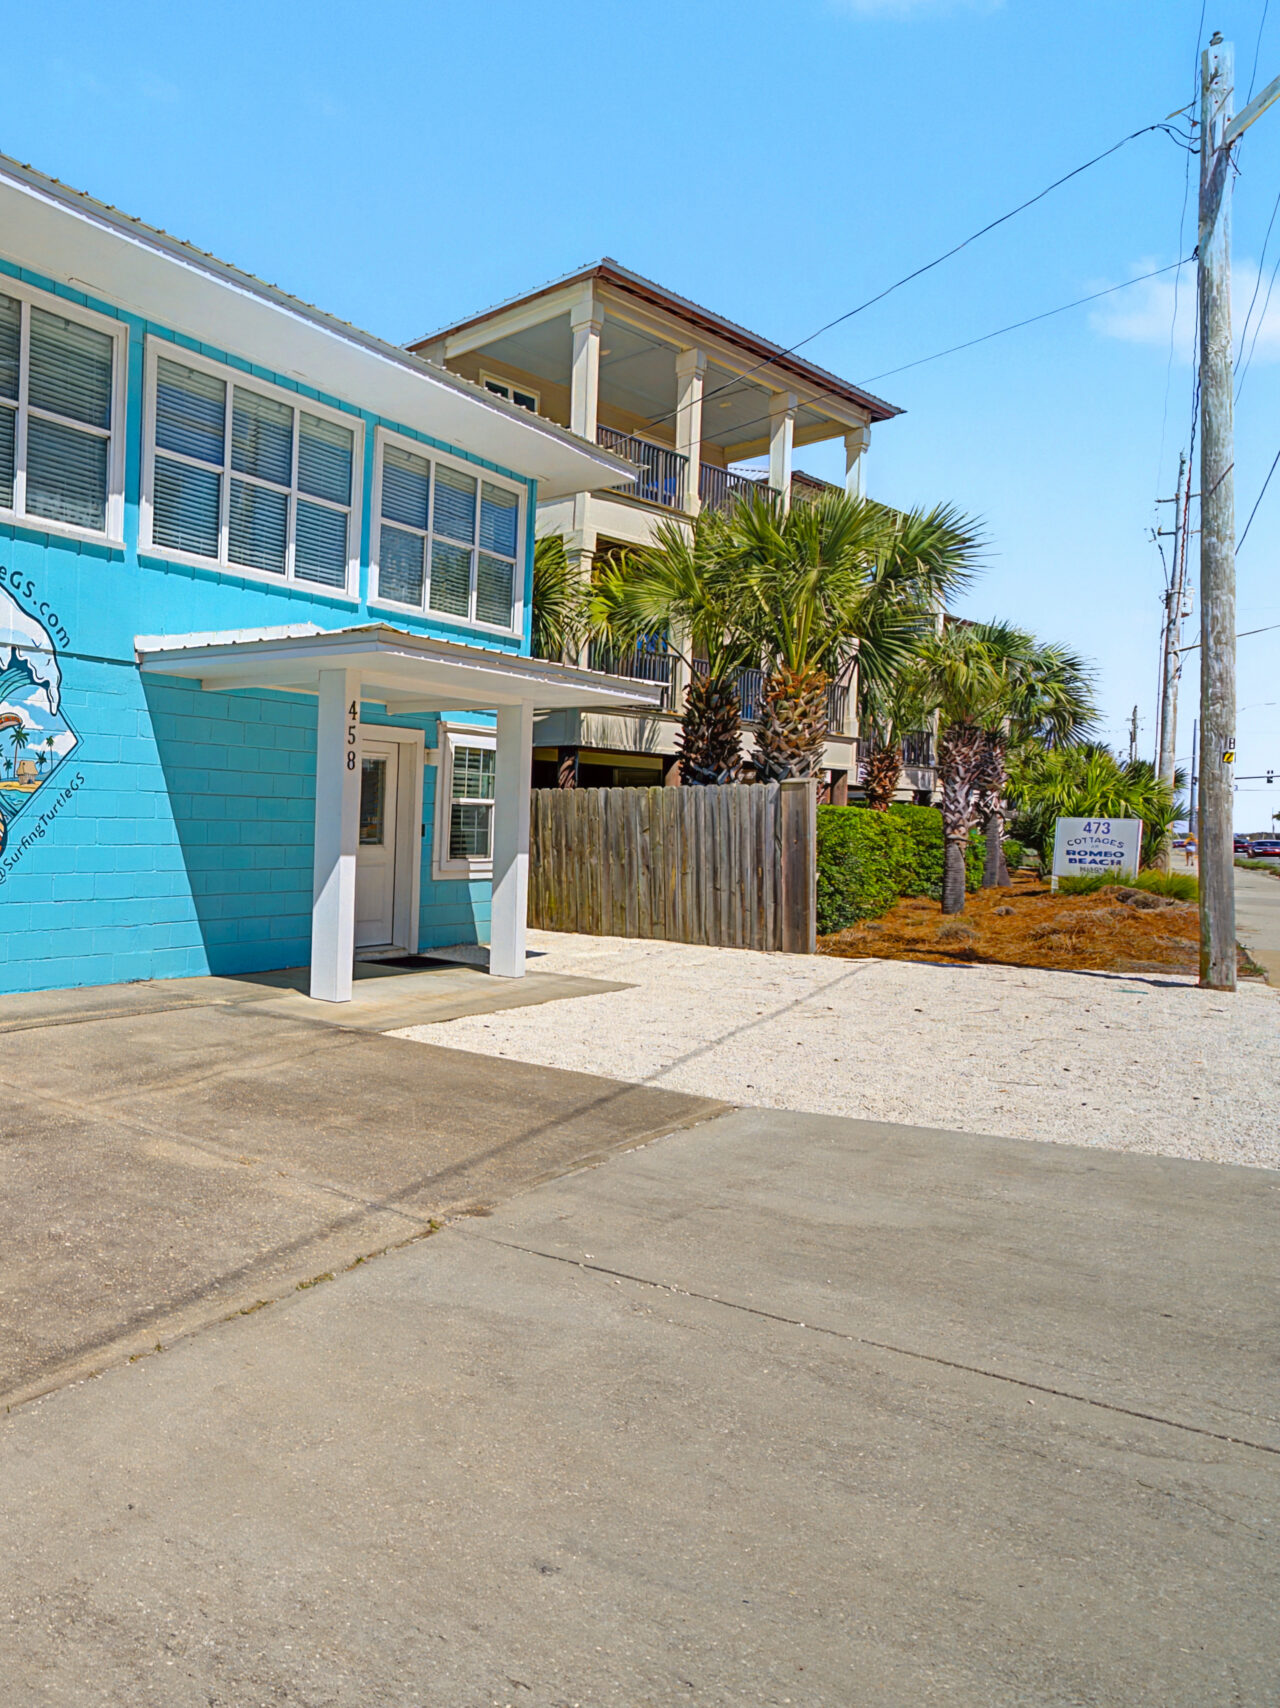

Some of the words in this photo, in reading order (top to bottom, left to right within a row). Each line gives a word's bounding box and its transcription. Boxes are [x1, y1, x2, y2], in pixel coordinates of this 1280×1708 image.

[347, 700, 357, 770] 458
[1082, 821, 1111, 834] 473
[1067, 837, 1124, 848] COTTAGES
